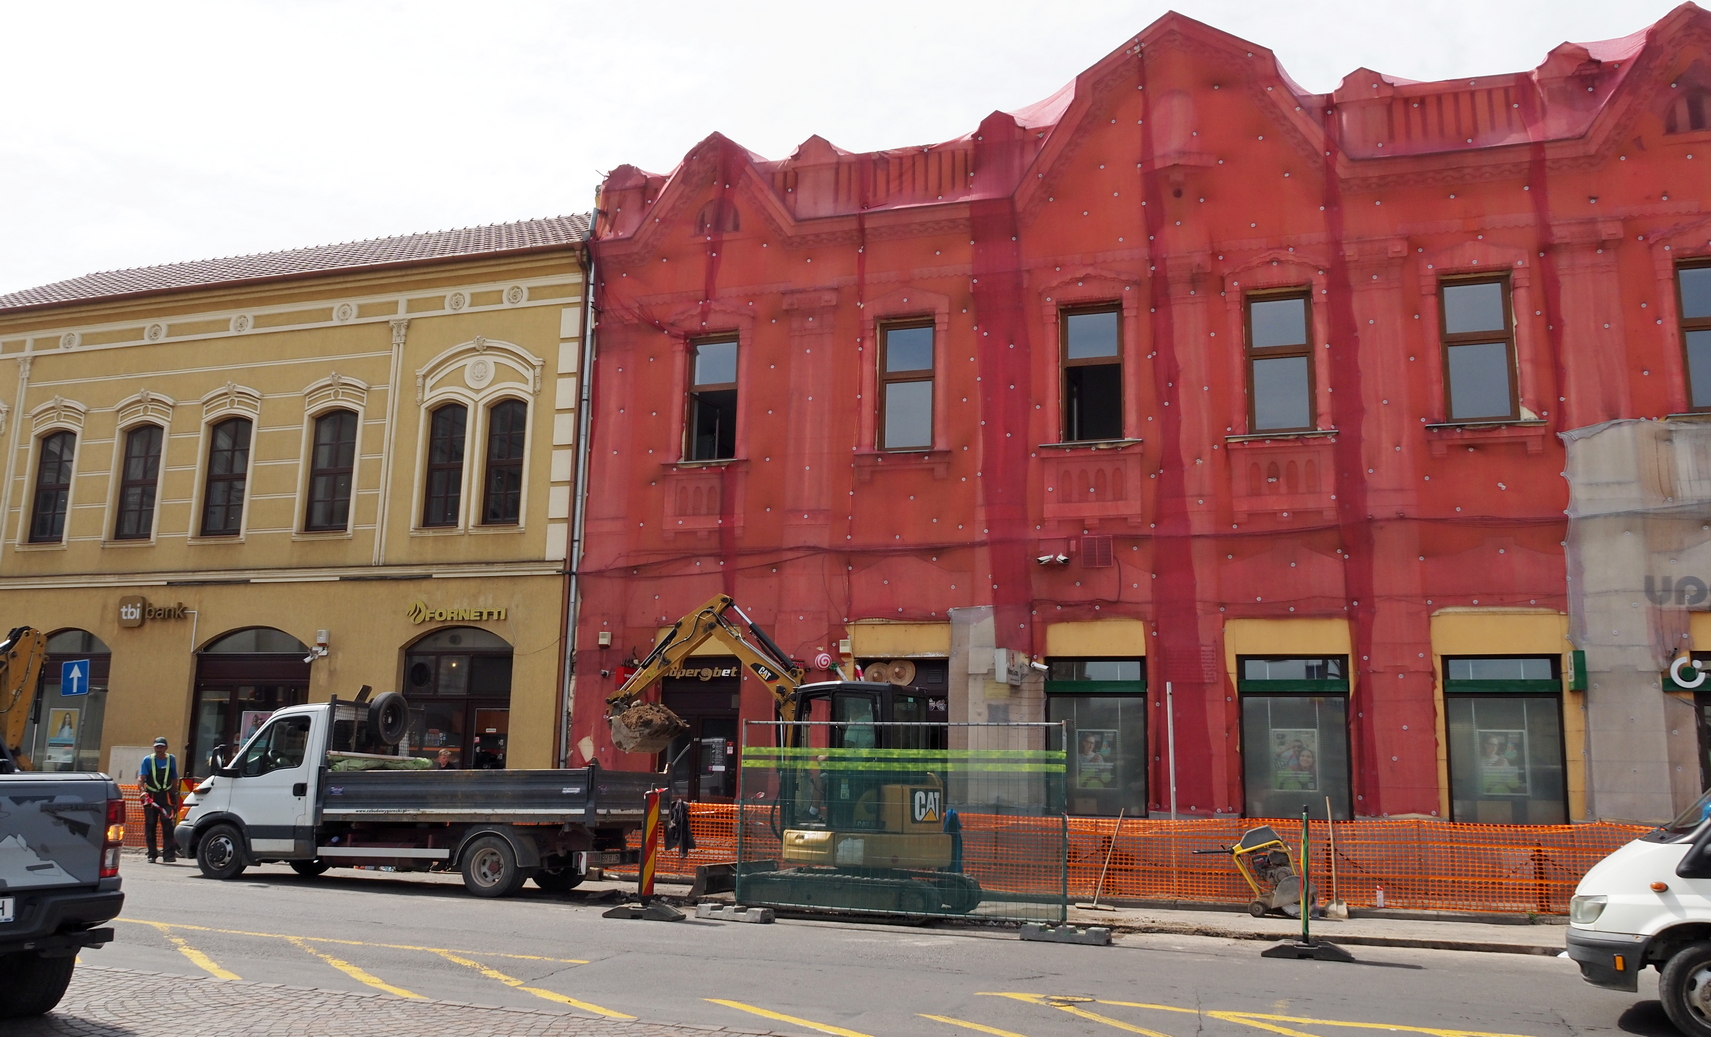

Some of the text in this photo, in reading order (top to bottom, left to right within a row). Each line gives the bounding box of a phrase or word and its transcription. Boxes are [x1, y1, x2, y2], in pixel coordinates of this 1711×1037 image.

[120, 601, 187, 620] tbi bank
[424, 607, 507, 622] FORNETTI
[758, 666, 771, 680] CAT
[914, 790, 940, 822] CAT
